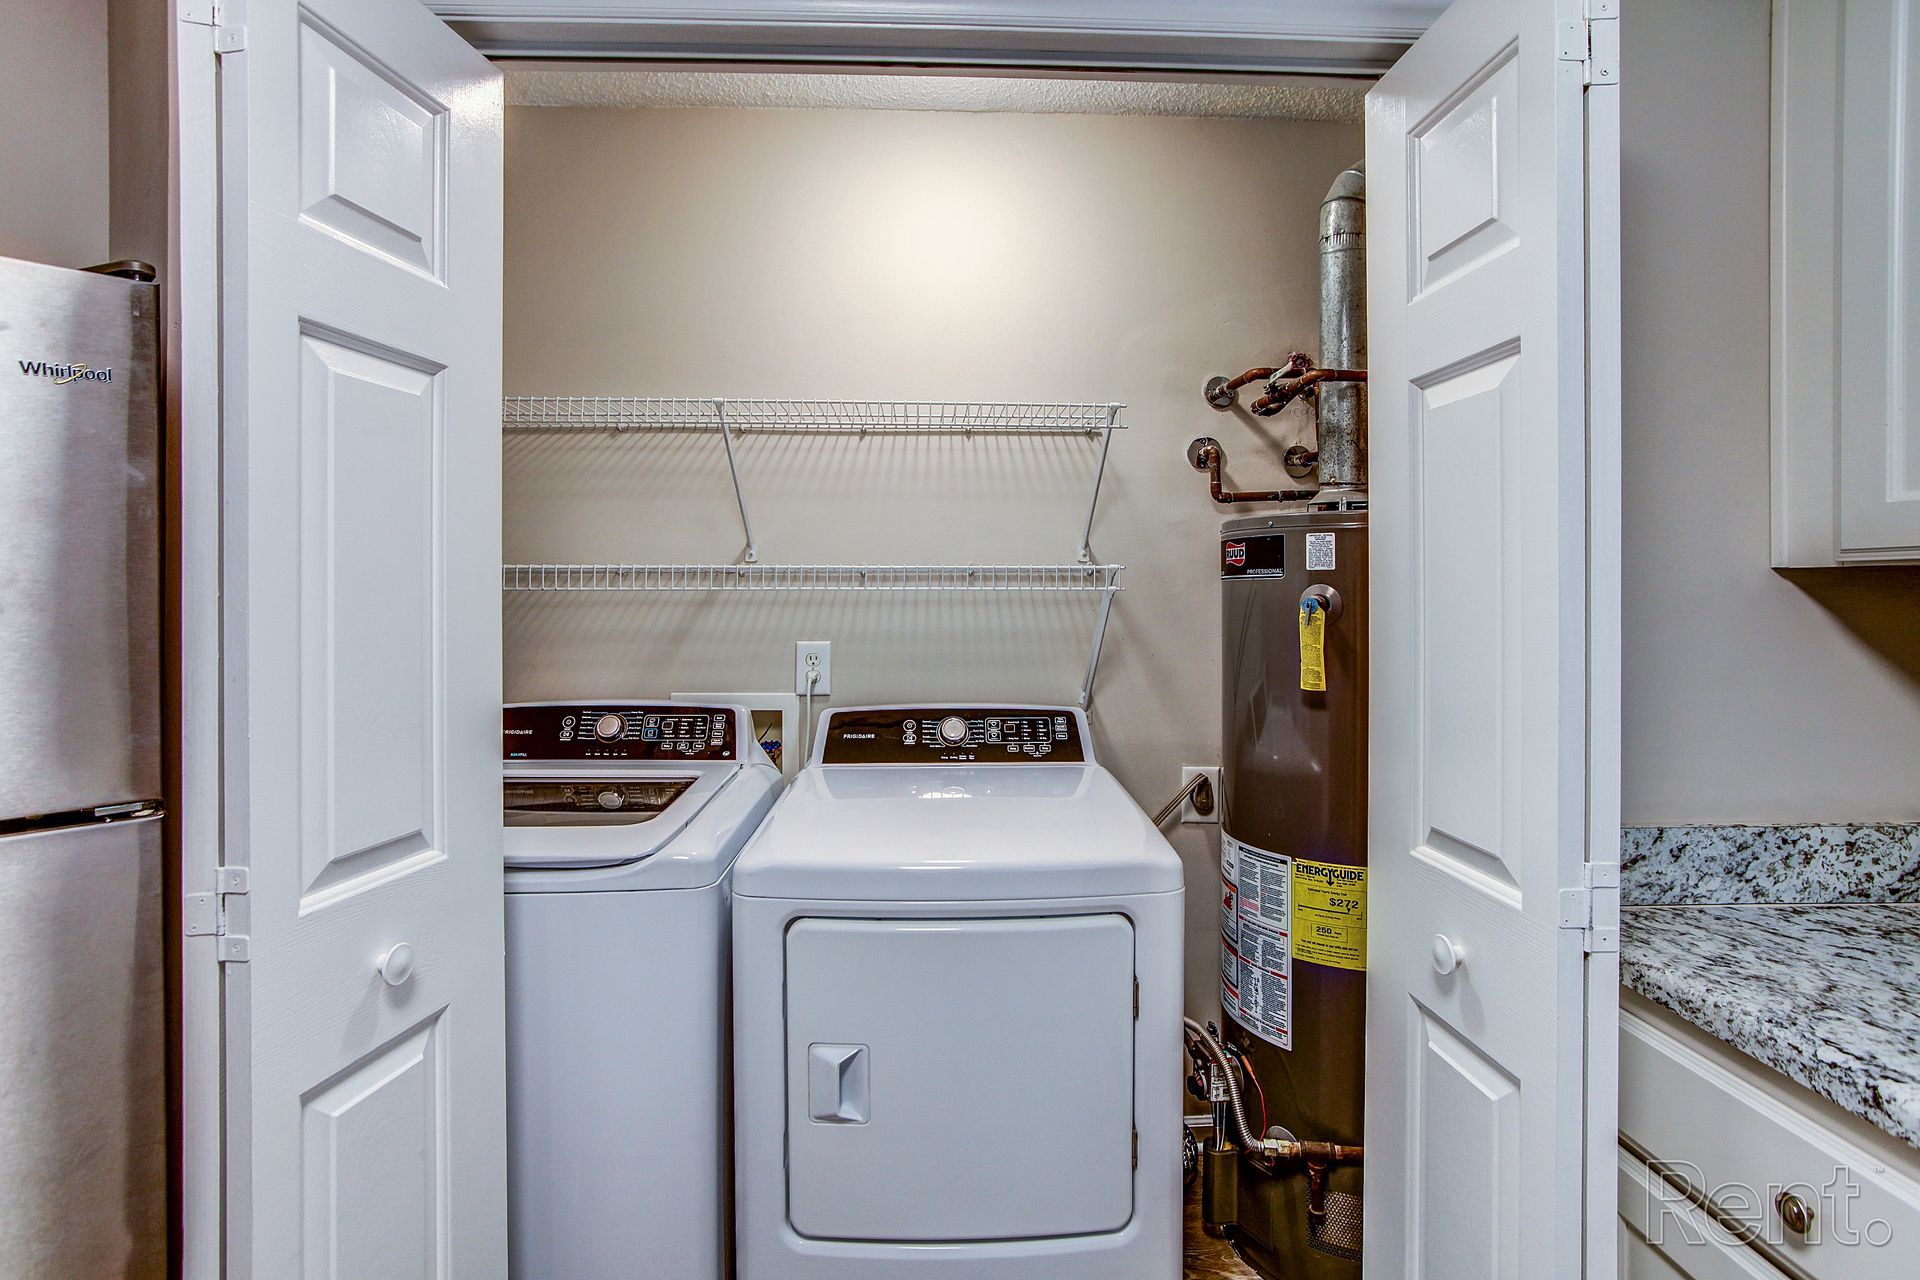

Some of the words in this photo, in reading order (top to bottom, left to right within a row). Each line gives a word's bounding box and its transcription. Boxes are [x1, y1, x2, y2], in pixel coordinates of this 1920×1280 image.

[18, 360, 112, 382] Whirlpool
[1226, 548, 1245, 559] RUUD
[1296, 863, 1364, 881] ENERGYGUIDE
[1329, 897, 1359, 909] $272
[1315, 925, 1332, 934] 250
